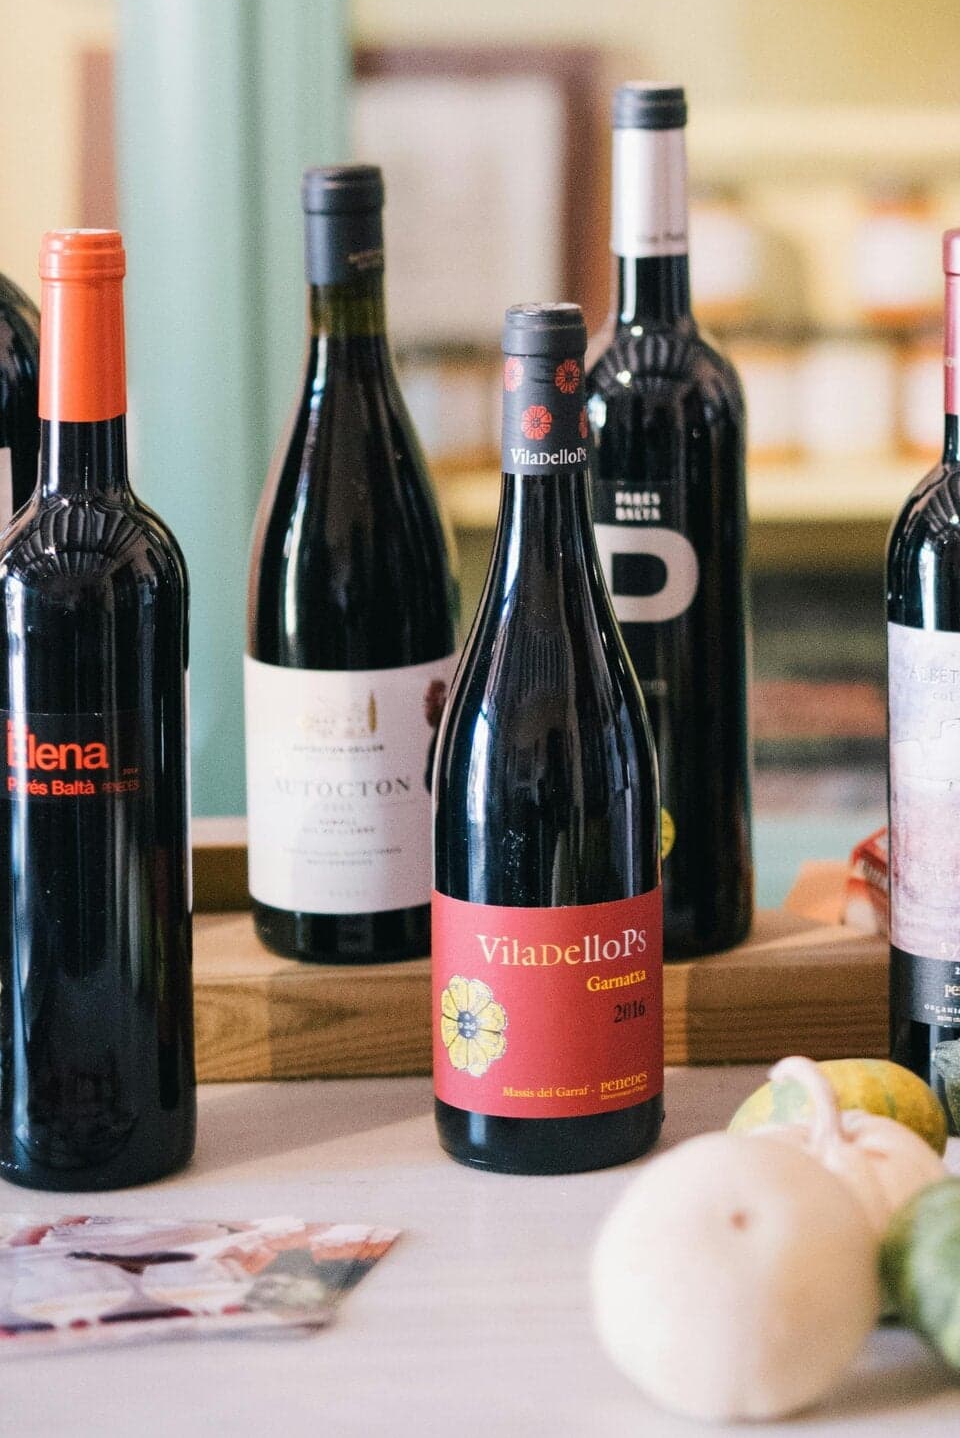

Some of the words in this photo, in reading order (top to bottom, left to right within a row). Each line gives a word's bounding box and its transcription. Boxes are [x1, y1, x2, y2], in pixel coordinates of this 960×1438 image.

[7, 775, 48, 796] Prés
[51, 779, 95, 796] Baltà
[586, 969, 647, 992] Garnatxa
[613, 999, 646, 1024] 2016
[536, 1086, 553, 1098] del
[555, 1083, 590, 1098] Garraf
